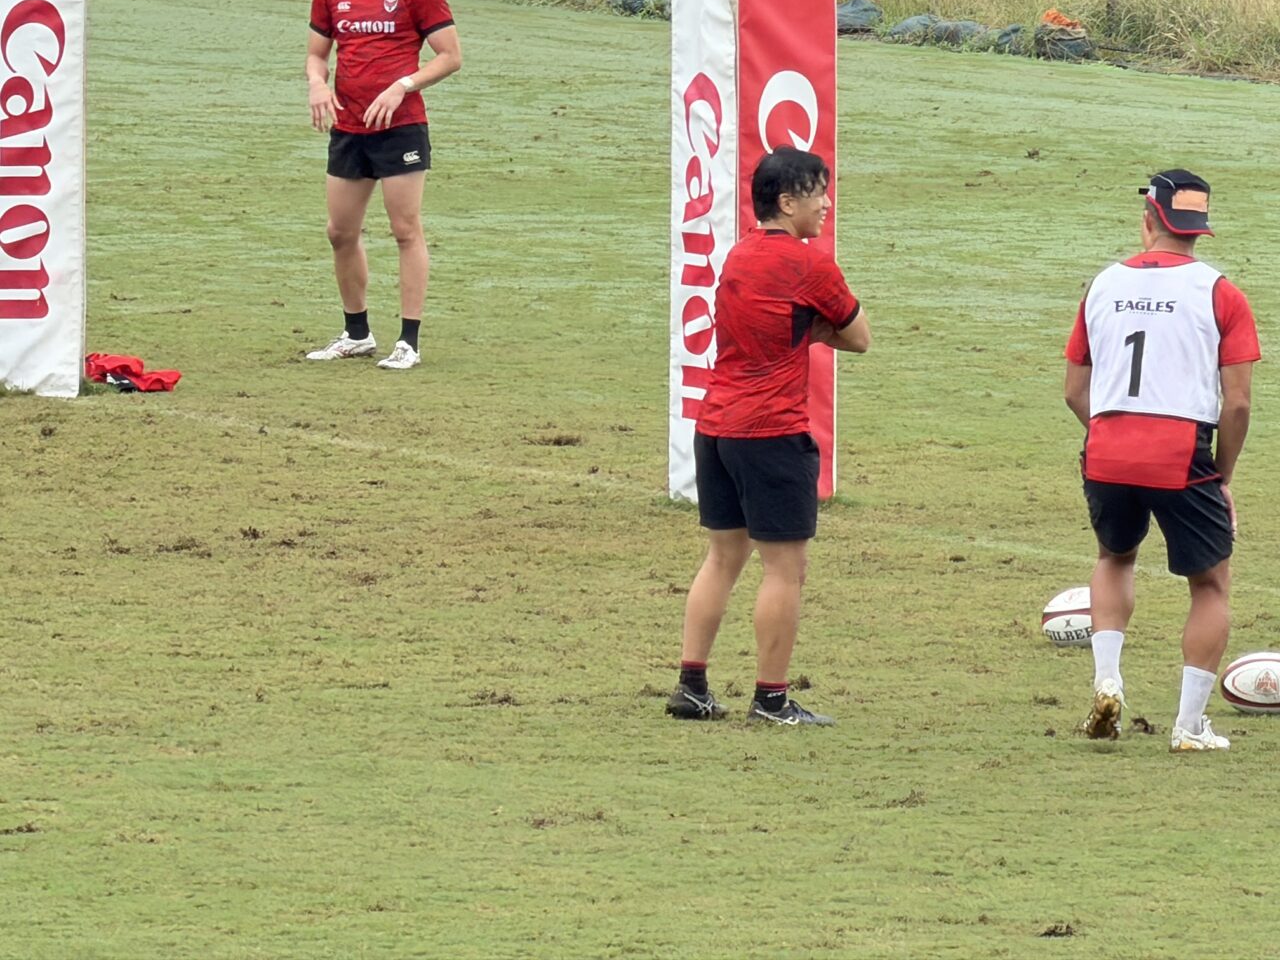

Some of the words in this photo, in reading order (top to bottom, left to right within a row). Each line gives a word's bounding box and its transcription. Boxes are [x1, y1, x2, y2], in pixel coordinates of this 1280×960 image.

[336, 20, 396, 34] Canon
[1113, 300, 1177, 314] EAGLES
[1124, 330, 1146, 398] 1
